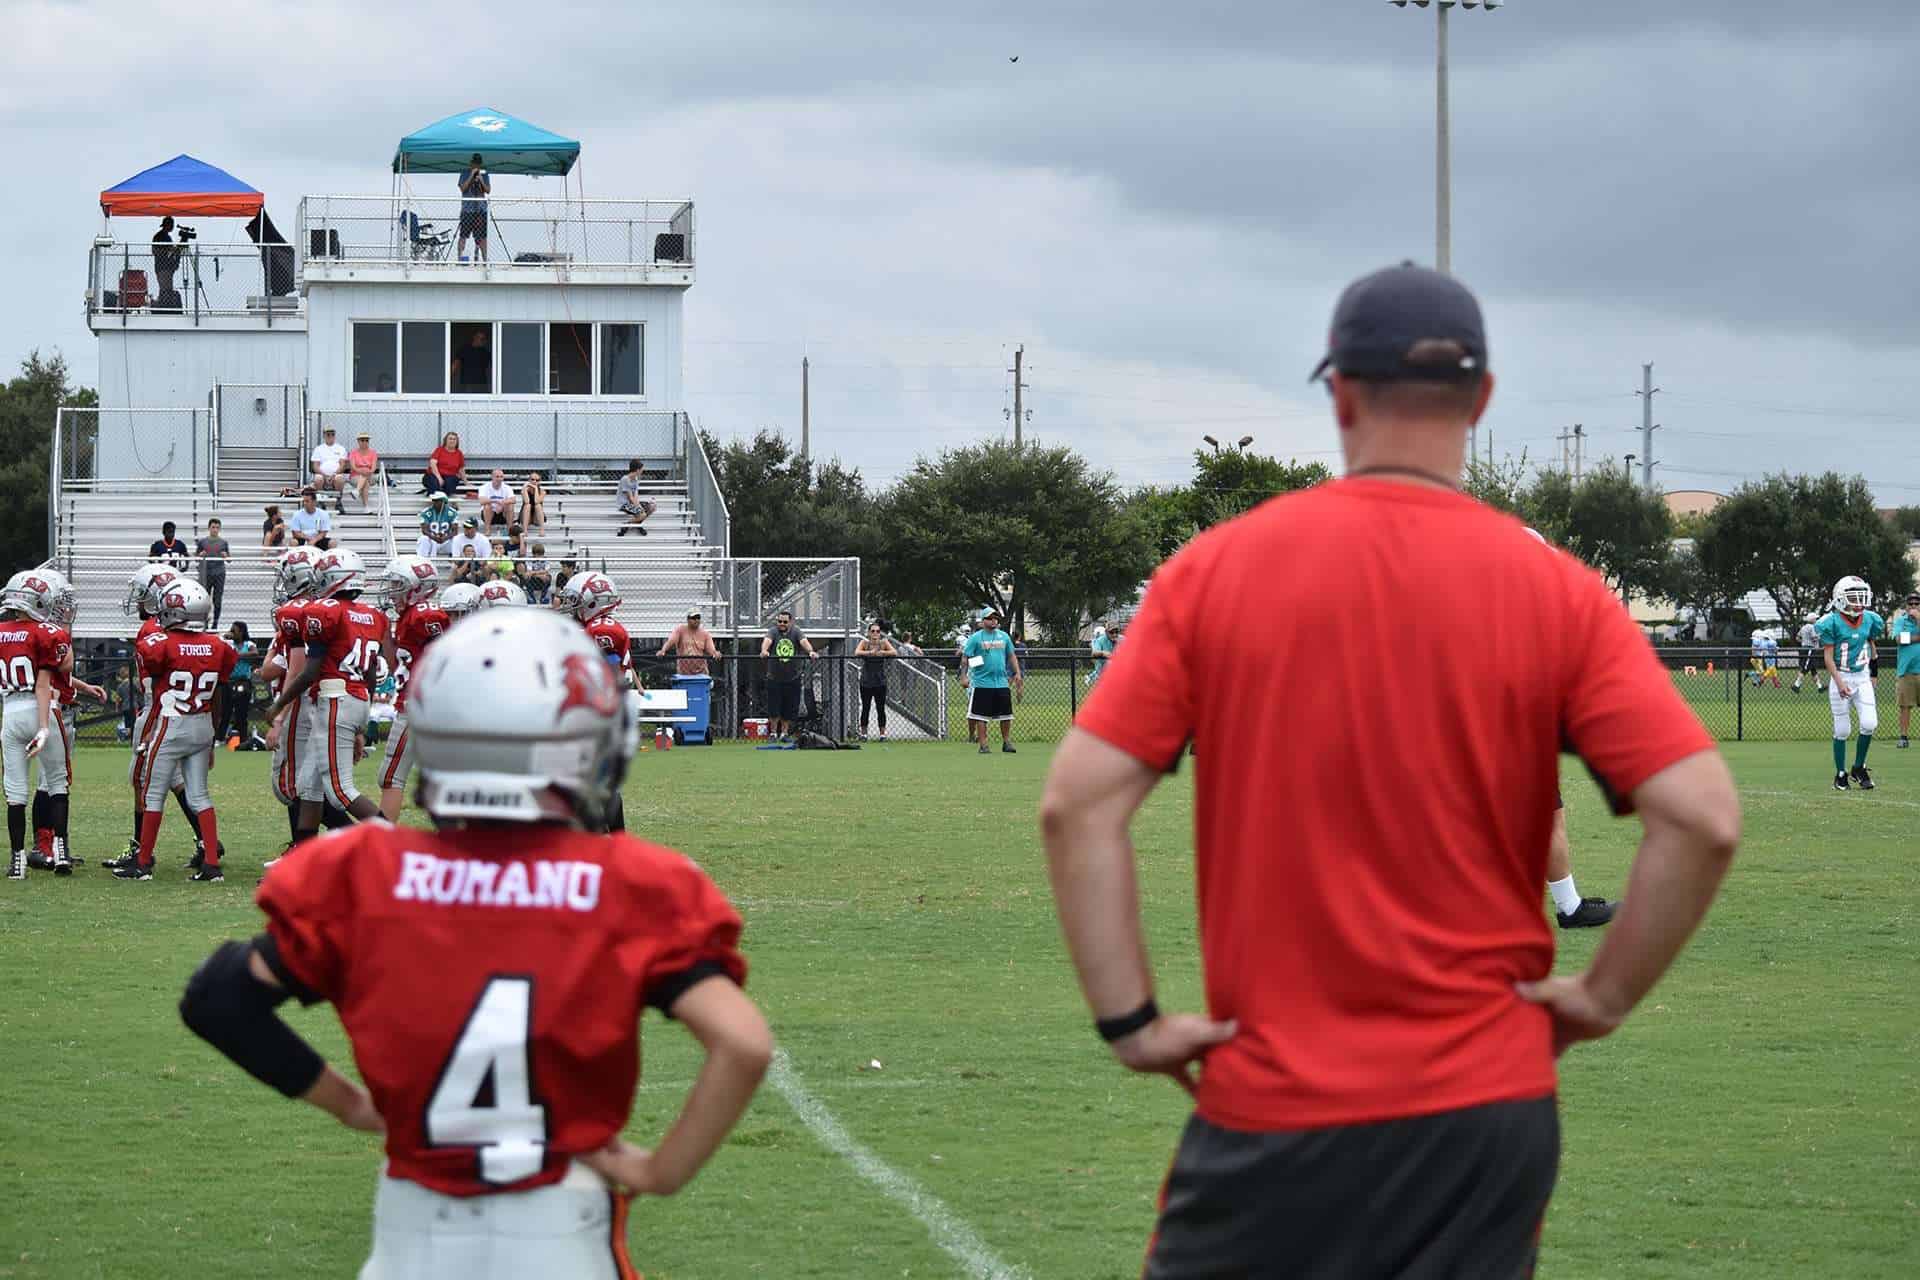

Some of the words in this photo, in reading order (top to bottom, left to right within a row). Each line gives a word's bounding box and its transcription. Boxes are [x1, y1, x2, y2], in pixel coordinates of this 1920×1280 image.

[178, 643, 213, 656] FORDE
[1839, 640, 1871, 672] 14
[167, 670, 219, 713] 22
[394, 851, 603, 911] ROMANO
[427, 975, 548, 1184] 4
